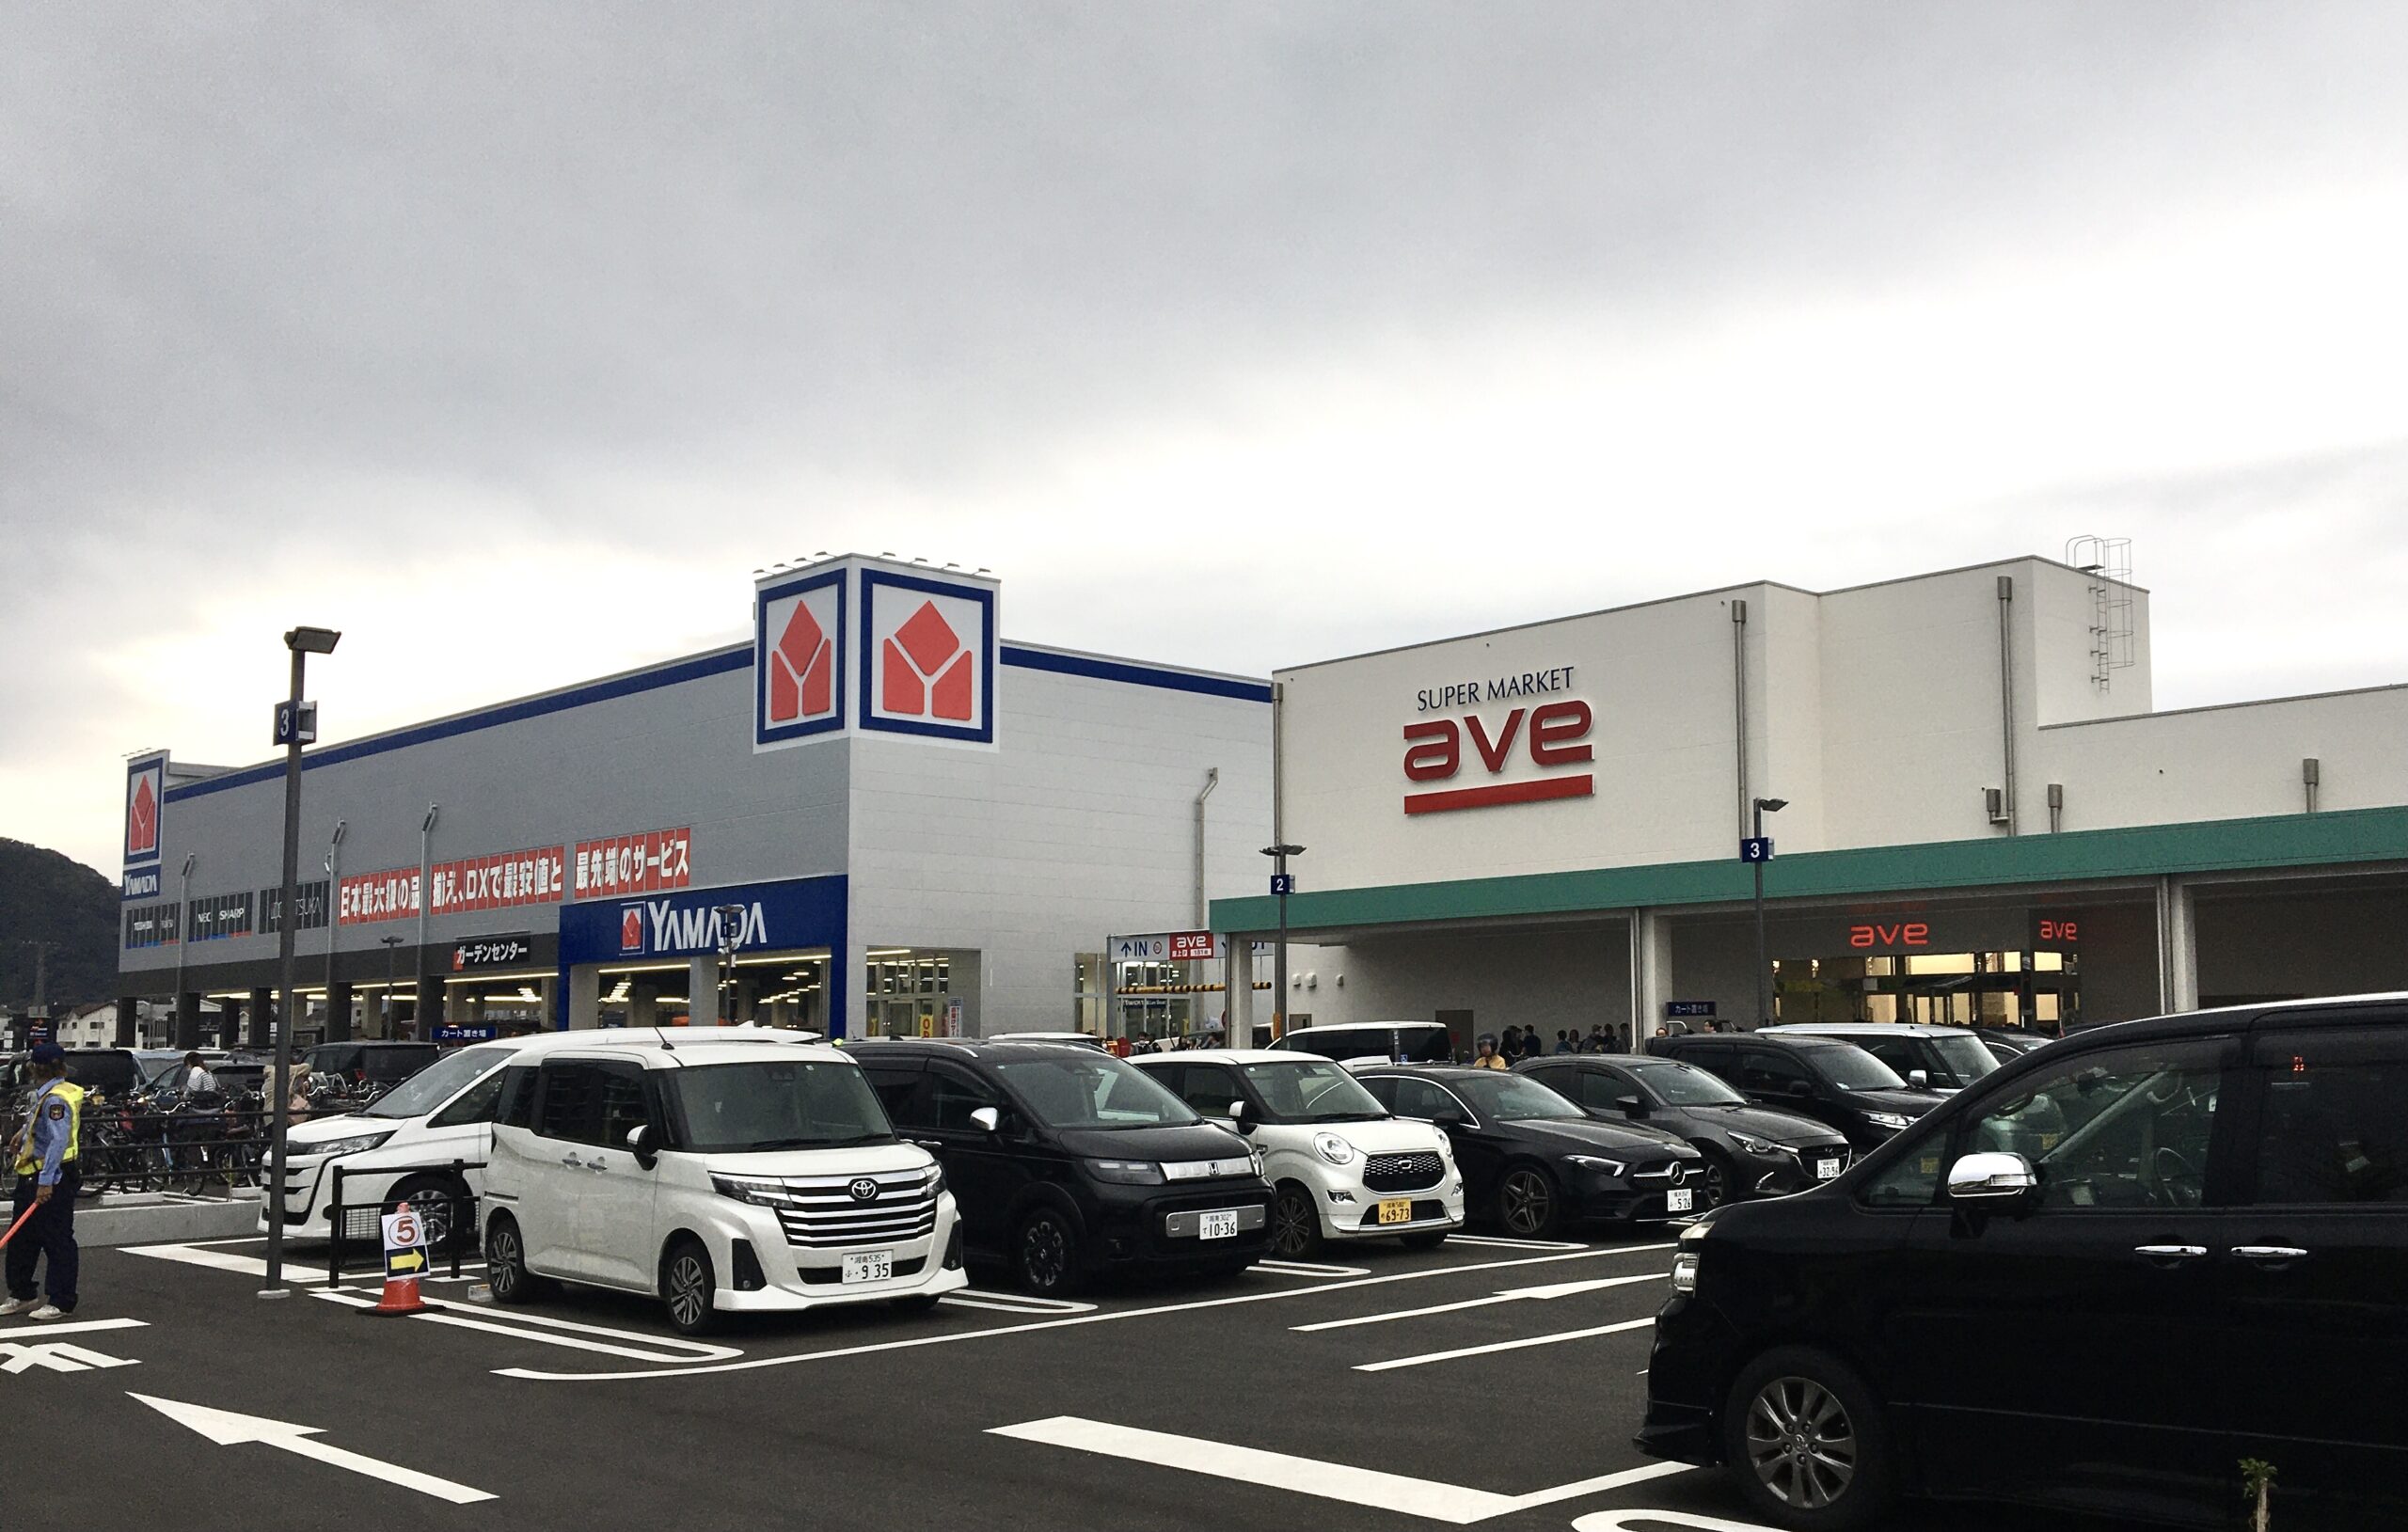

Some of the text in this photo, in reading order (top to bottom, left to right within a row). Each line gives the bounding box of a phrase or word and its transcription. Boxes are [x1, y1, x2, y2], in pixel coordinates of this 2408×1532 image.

[1418, 666, 1575, 711] SUPER MARKET
[280, 708, 289, 736] 3
[1403, 700, 1593, 782] ave
[1750, 842, 1760, 859] 3
[576, 839, 689, 890] 最先端のサービス
[124, 875, 158, 896] YAMADA
[1276, 877, 1284, 892] 2
[198, 913, 211, 924] NEC
[219, 908, 245, 921] SHARP
[648, 900, 767, 952] YAMADA
[1850, 923, 1929, 948] ave
[2040, 920, 2078, 941] ave
[456, 941, 528, 964] ガーデンセンター
[1134, 941, 1148, 956] IN
[1176, 936, 1207, 949] ave
[441, 1029, 486, 1037] カート置き場
[397, 1219, 416, 1242] 5
